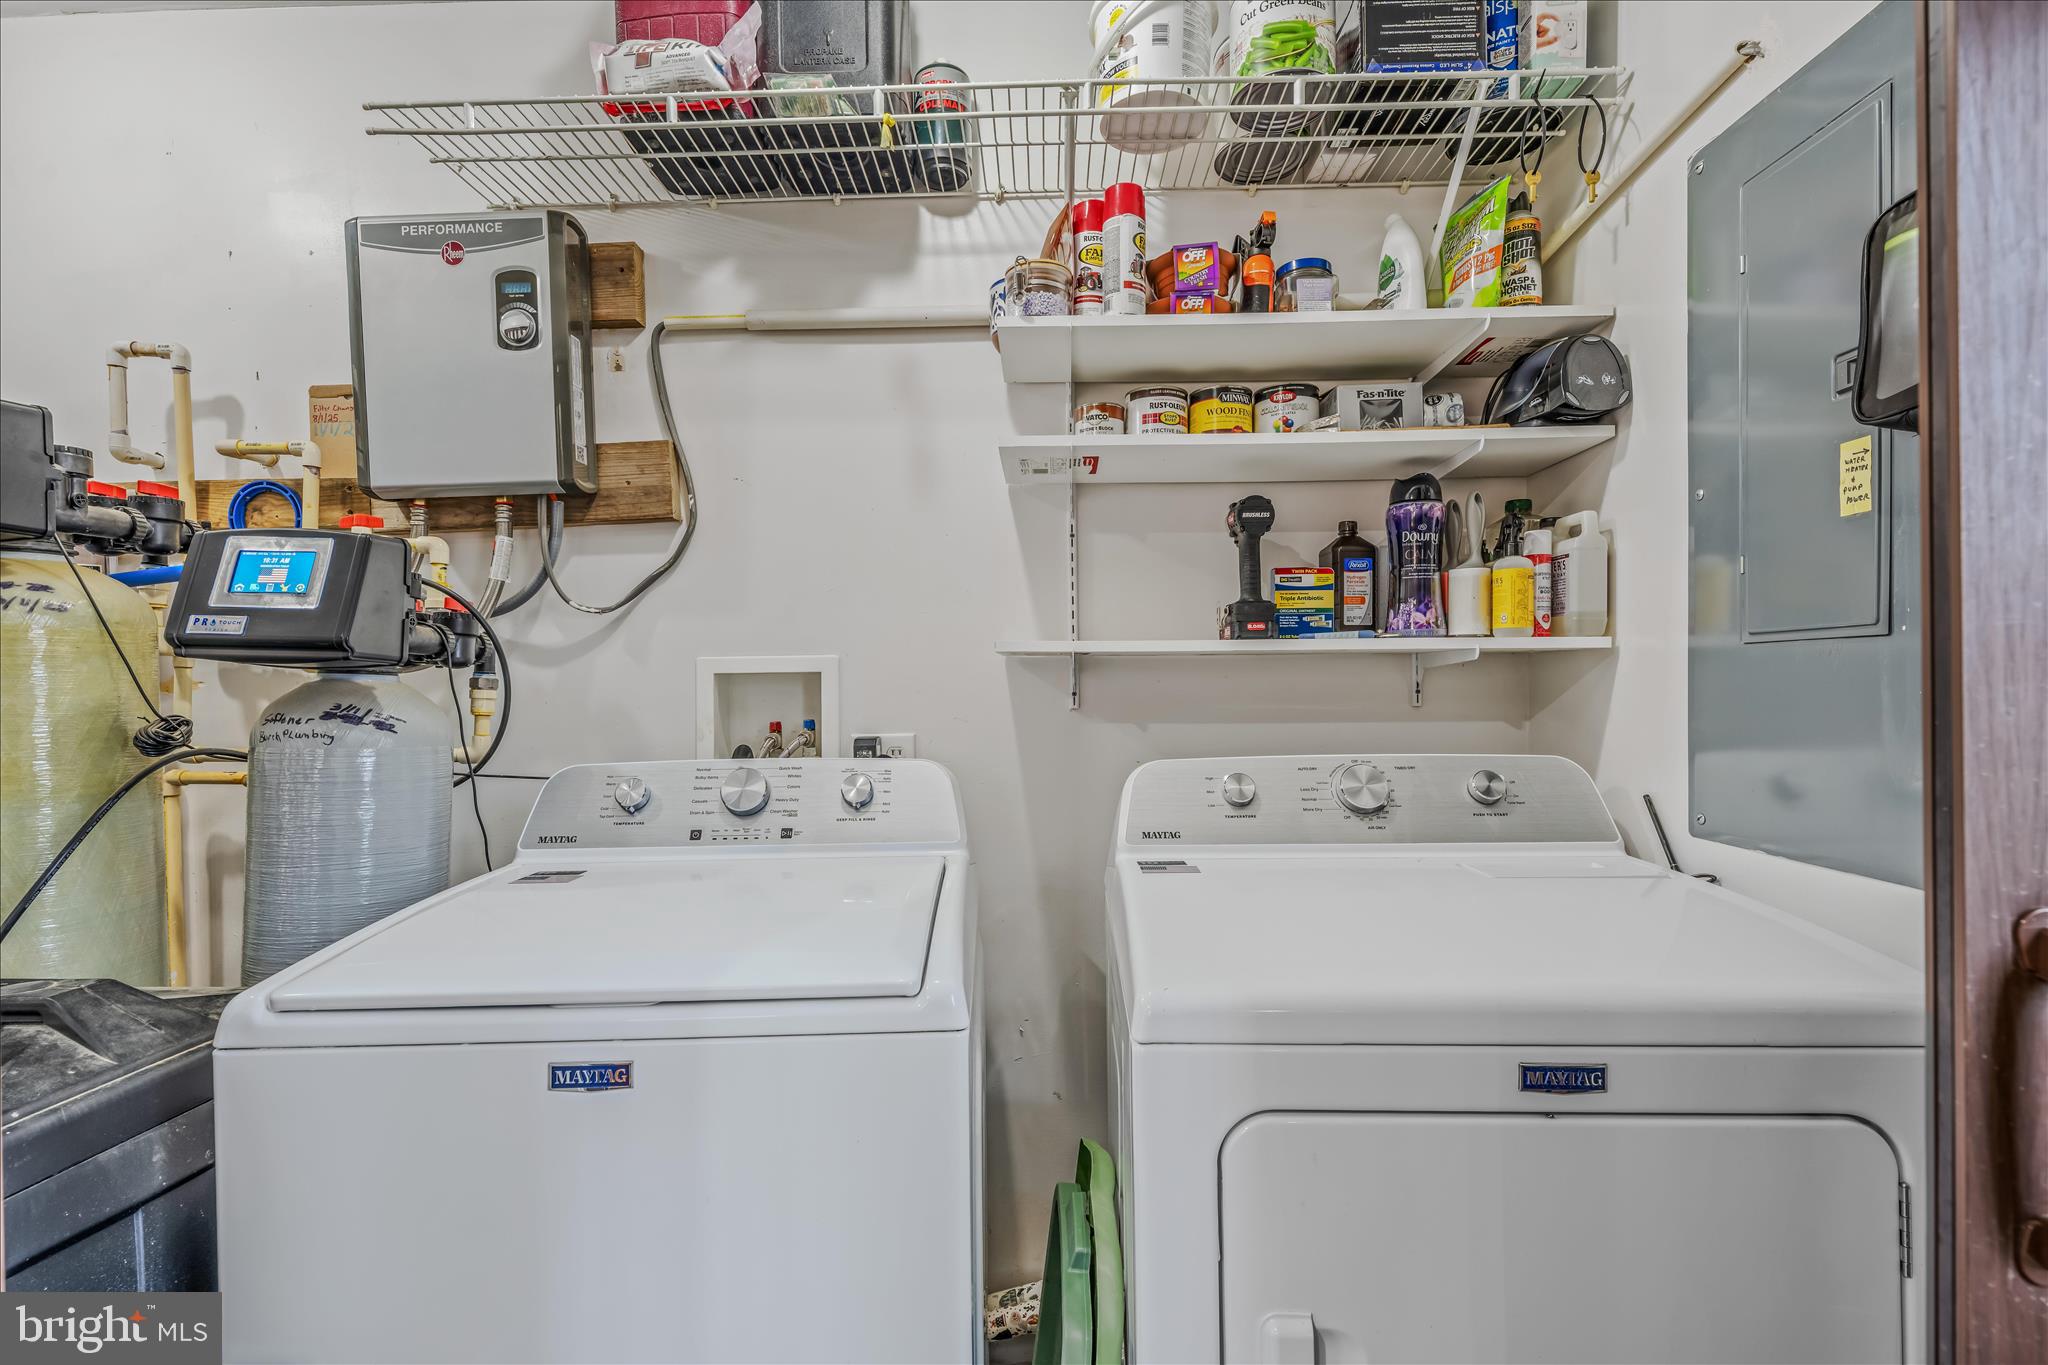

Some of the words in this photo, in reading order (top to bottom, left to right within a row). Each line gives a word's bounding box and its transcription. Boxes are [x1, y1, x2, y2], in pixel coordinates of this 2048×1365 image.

[1240, 8, 1257, 25] Cut
[1260, 0, 1294, 12] Green
[833, 57, 856, 66] CASE
[401, 222, 503, 236] PERFORMANCE
[1505, 237, 1533, 255] HOT
[1182, 249, 1208, 262] OFF!
[1502, 246, 1536, 267] SHOT
[1502, 276, 1530, 289] WASP
[1500, 283, 1538, 298] HORNET
[1181, 298, 1205, 310] OFF!
[1206, 406, 1237, 416] WOOD
[1844, 455, 1866, 465] WATER
[1845, 463, 1869, 473] HEATER
[1846, 493, 1871, 504] POWER
[1401, 530, 1440, 545] Downy
[537, 835, 577, 844] MAYTAG
[1142, 831, 1181, 840] MAYTAG
[554, 1068, 628, 1085] MAYTAG
[1525, 1071, 1603, 1087] MAYTAG
